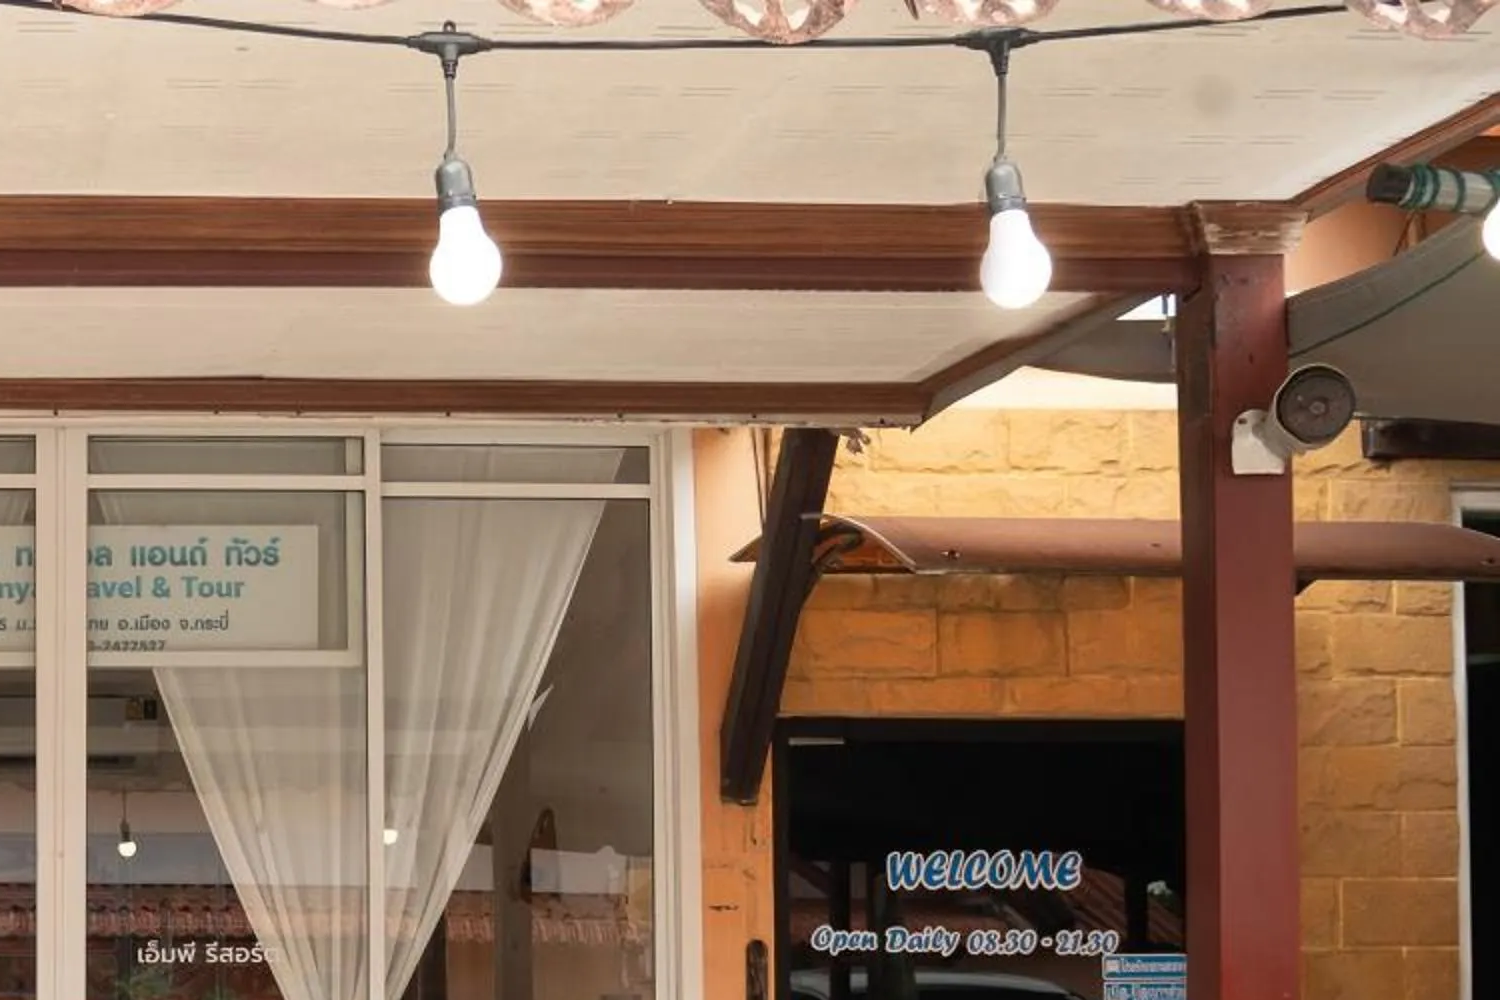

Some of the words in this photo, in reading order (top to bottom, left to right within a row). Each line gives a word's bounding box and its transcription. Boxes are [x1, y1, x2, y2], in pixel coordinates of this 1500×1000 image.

[225, 537, 280, 567] ทัวร์
[152, 577, 171, 599] &
[181, 577, 244, 599] Tour
[886, 849, 1082, 891] WELCOME
[136, 939, 197, 963] เอ็มพี
[812, 925, 878, 956] Open
[885, 925, 960, 956] Daily
[967, 930, 1037, 955] 08.30
[1055, 930, 1119, 955] 21.30
